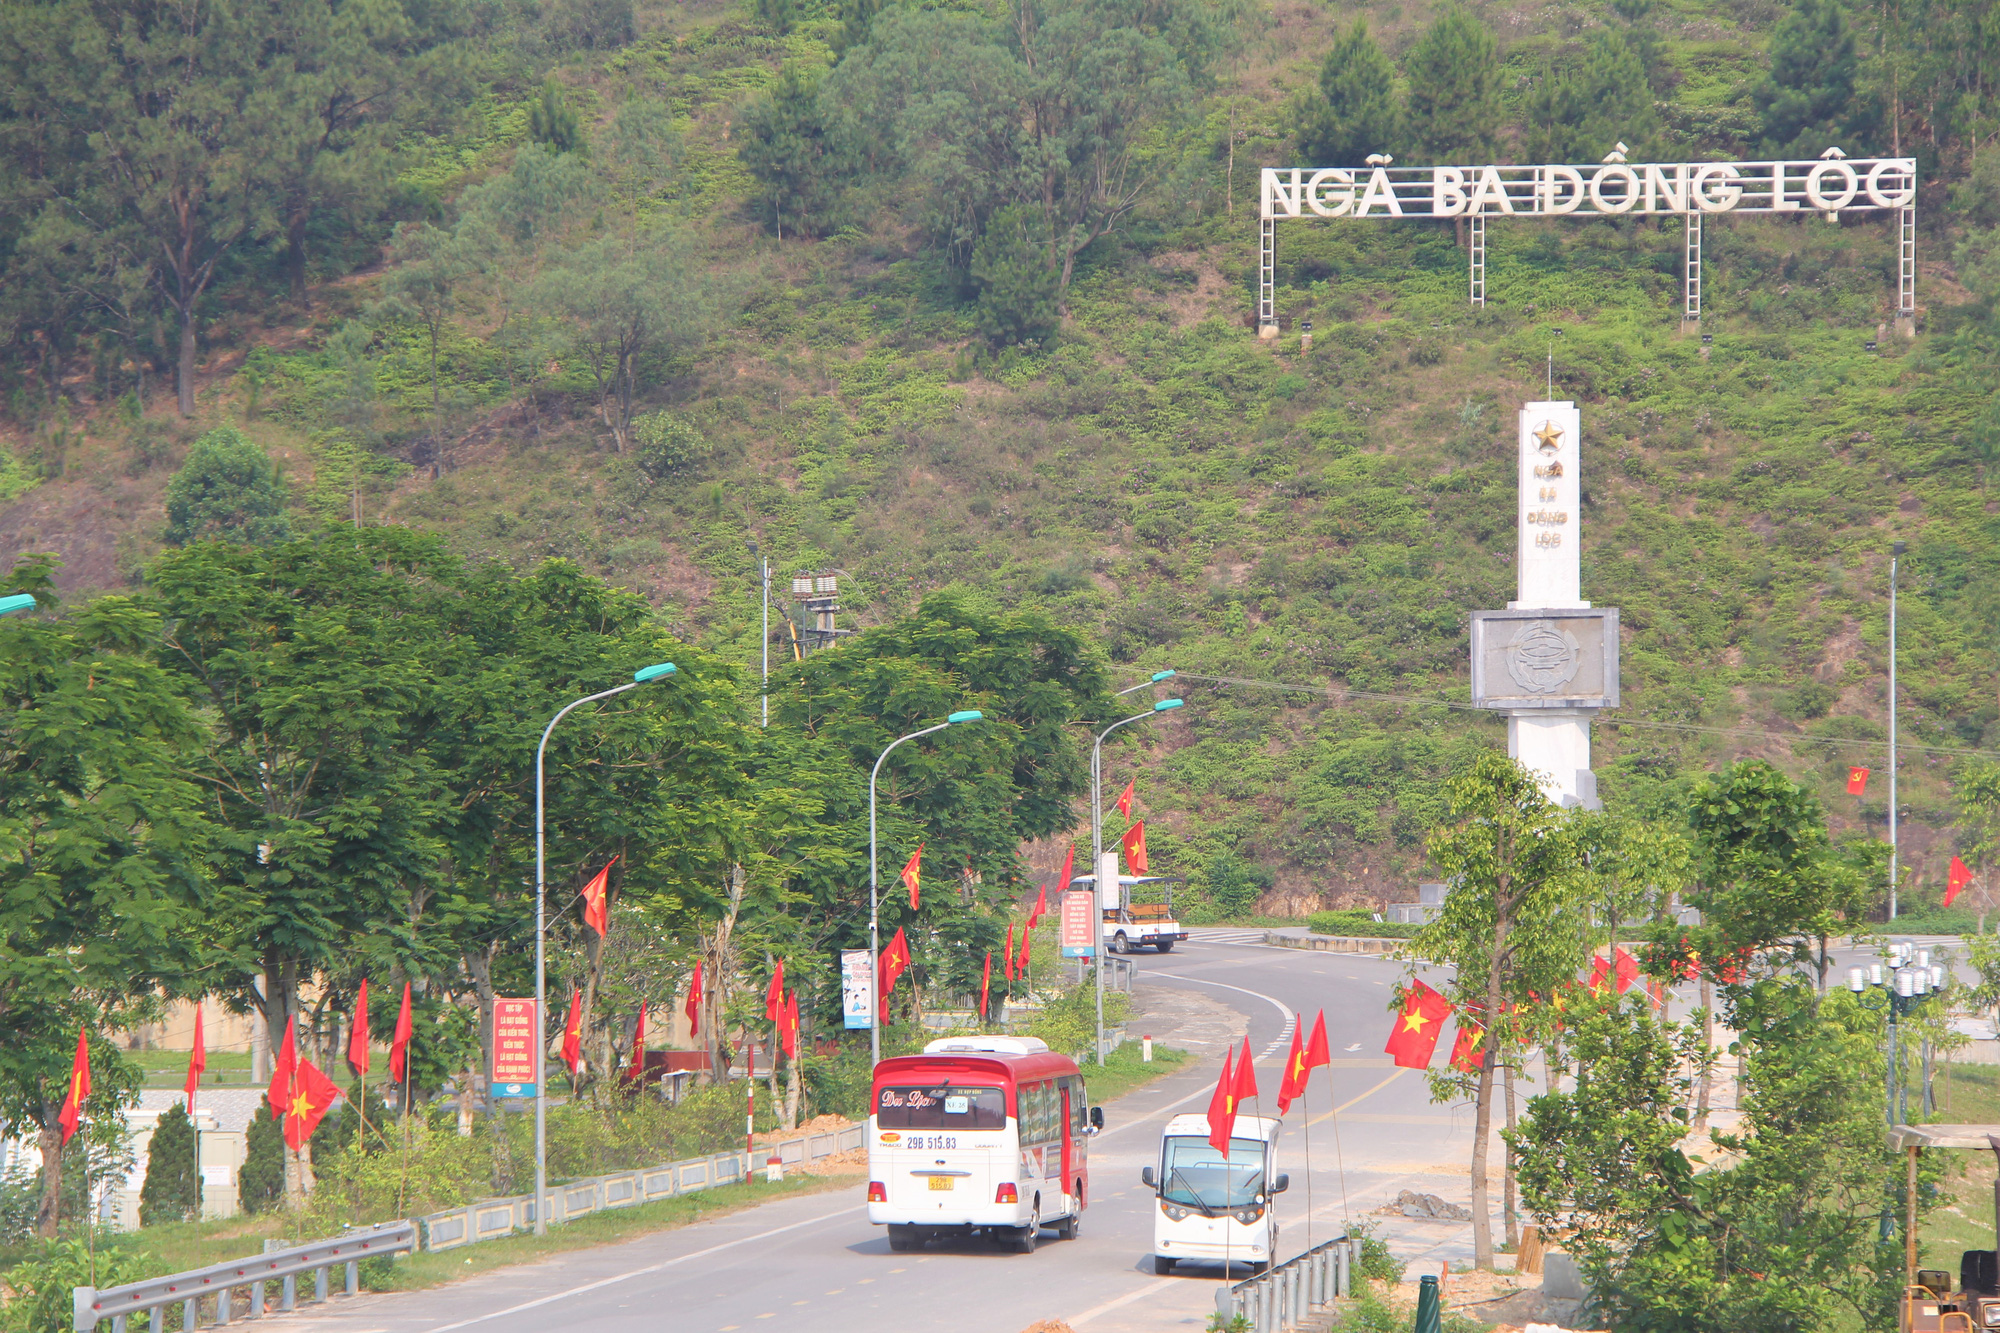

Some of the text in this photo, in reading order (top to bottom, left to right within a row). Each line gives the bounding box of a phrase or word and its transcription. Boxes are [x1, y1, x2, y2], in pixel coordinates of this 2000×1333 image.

[1261, 141, 1916, 222] NGÃ BA ĐỒNG LỘC
[907, 1137, 924, 1149] 29B
[928, 1136, 956, 1150] 515.83
